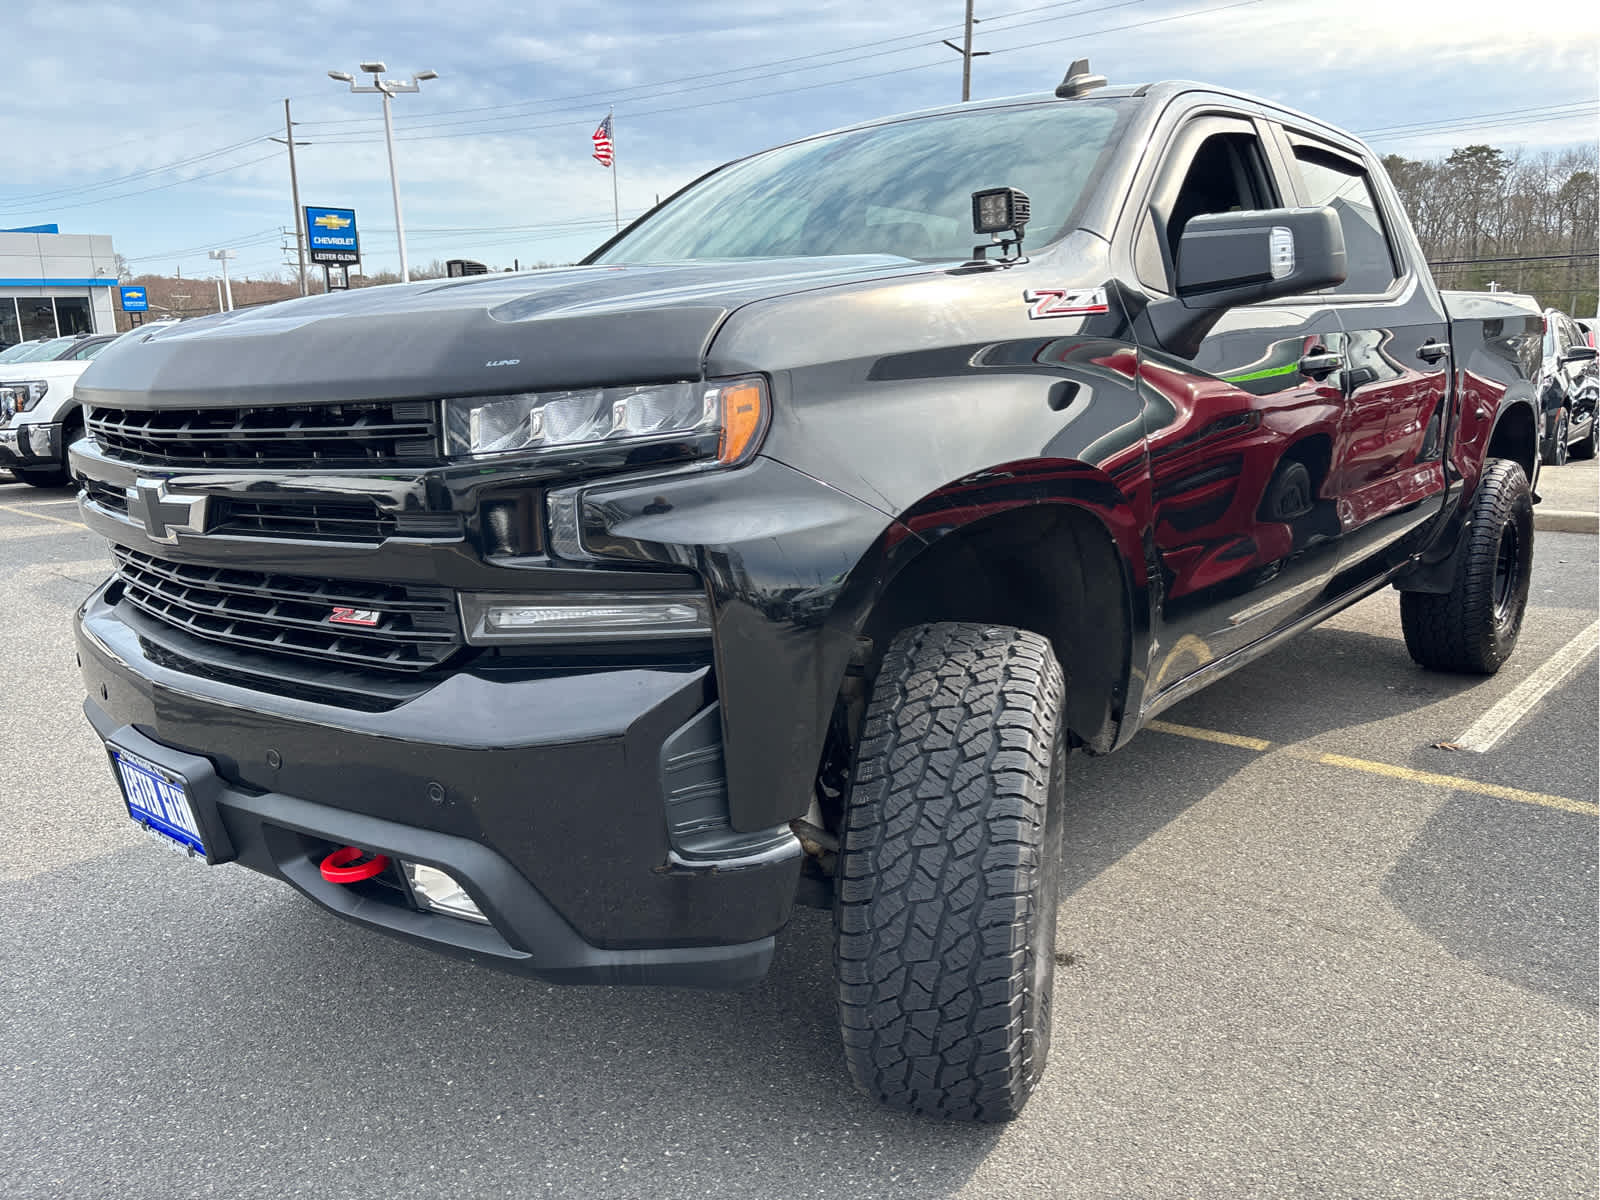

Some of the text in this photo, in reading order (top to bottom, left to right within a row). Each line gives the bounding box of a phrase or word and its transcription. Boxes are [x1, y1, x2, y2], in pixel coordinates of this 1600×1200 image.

[313, 236, 355, 246] CHEVROLET
[1023, 287, 1110, 320] Z71
[486, 359, 520, 367] LUND
[328, 607, 379, 626] Z71
[118, 761, 166, 819] LESTER
